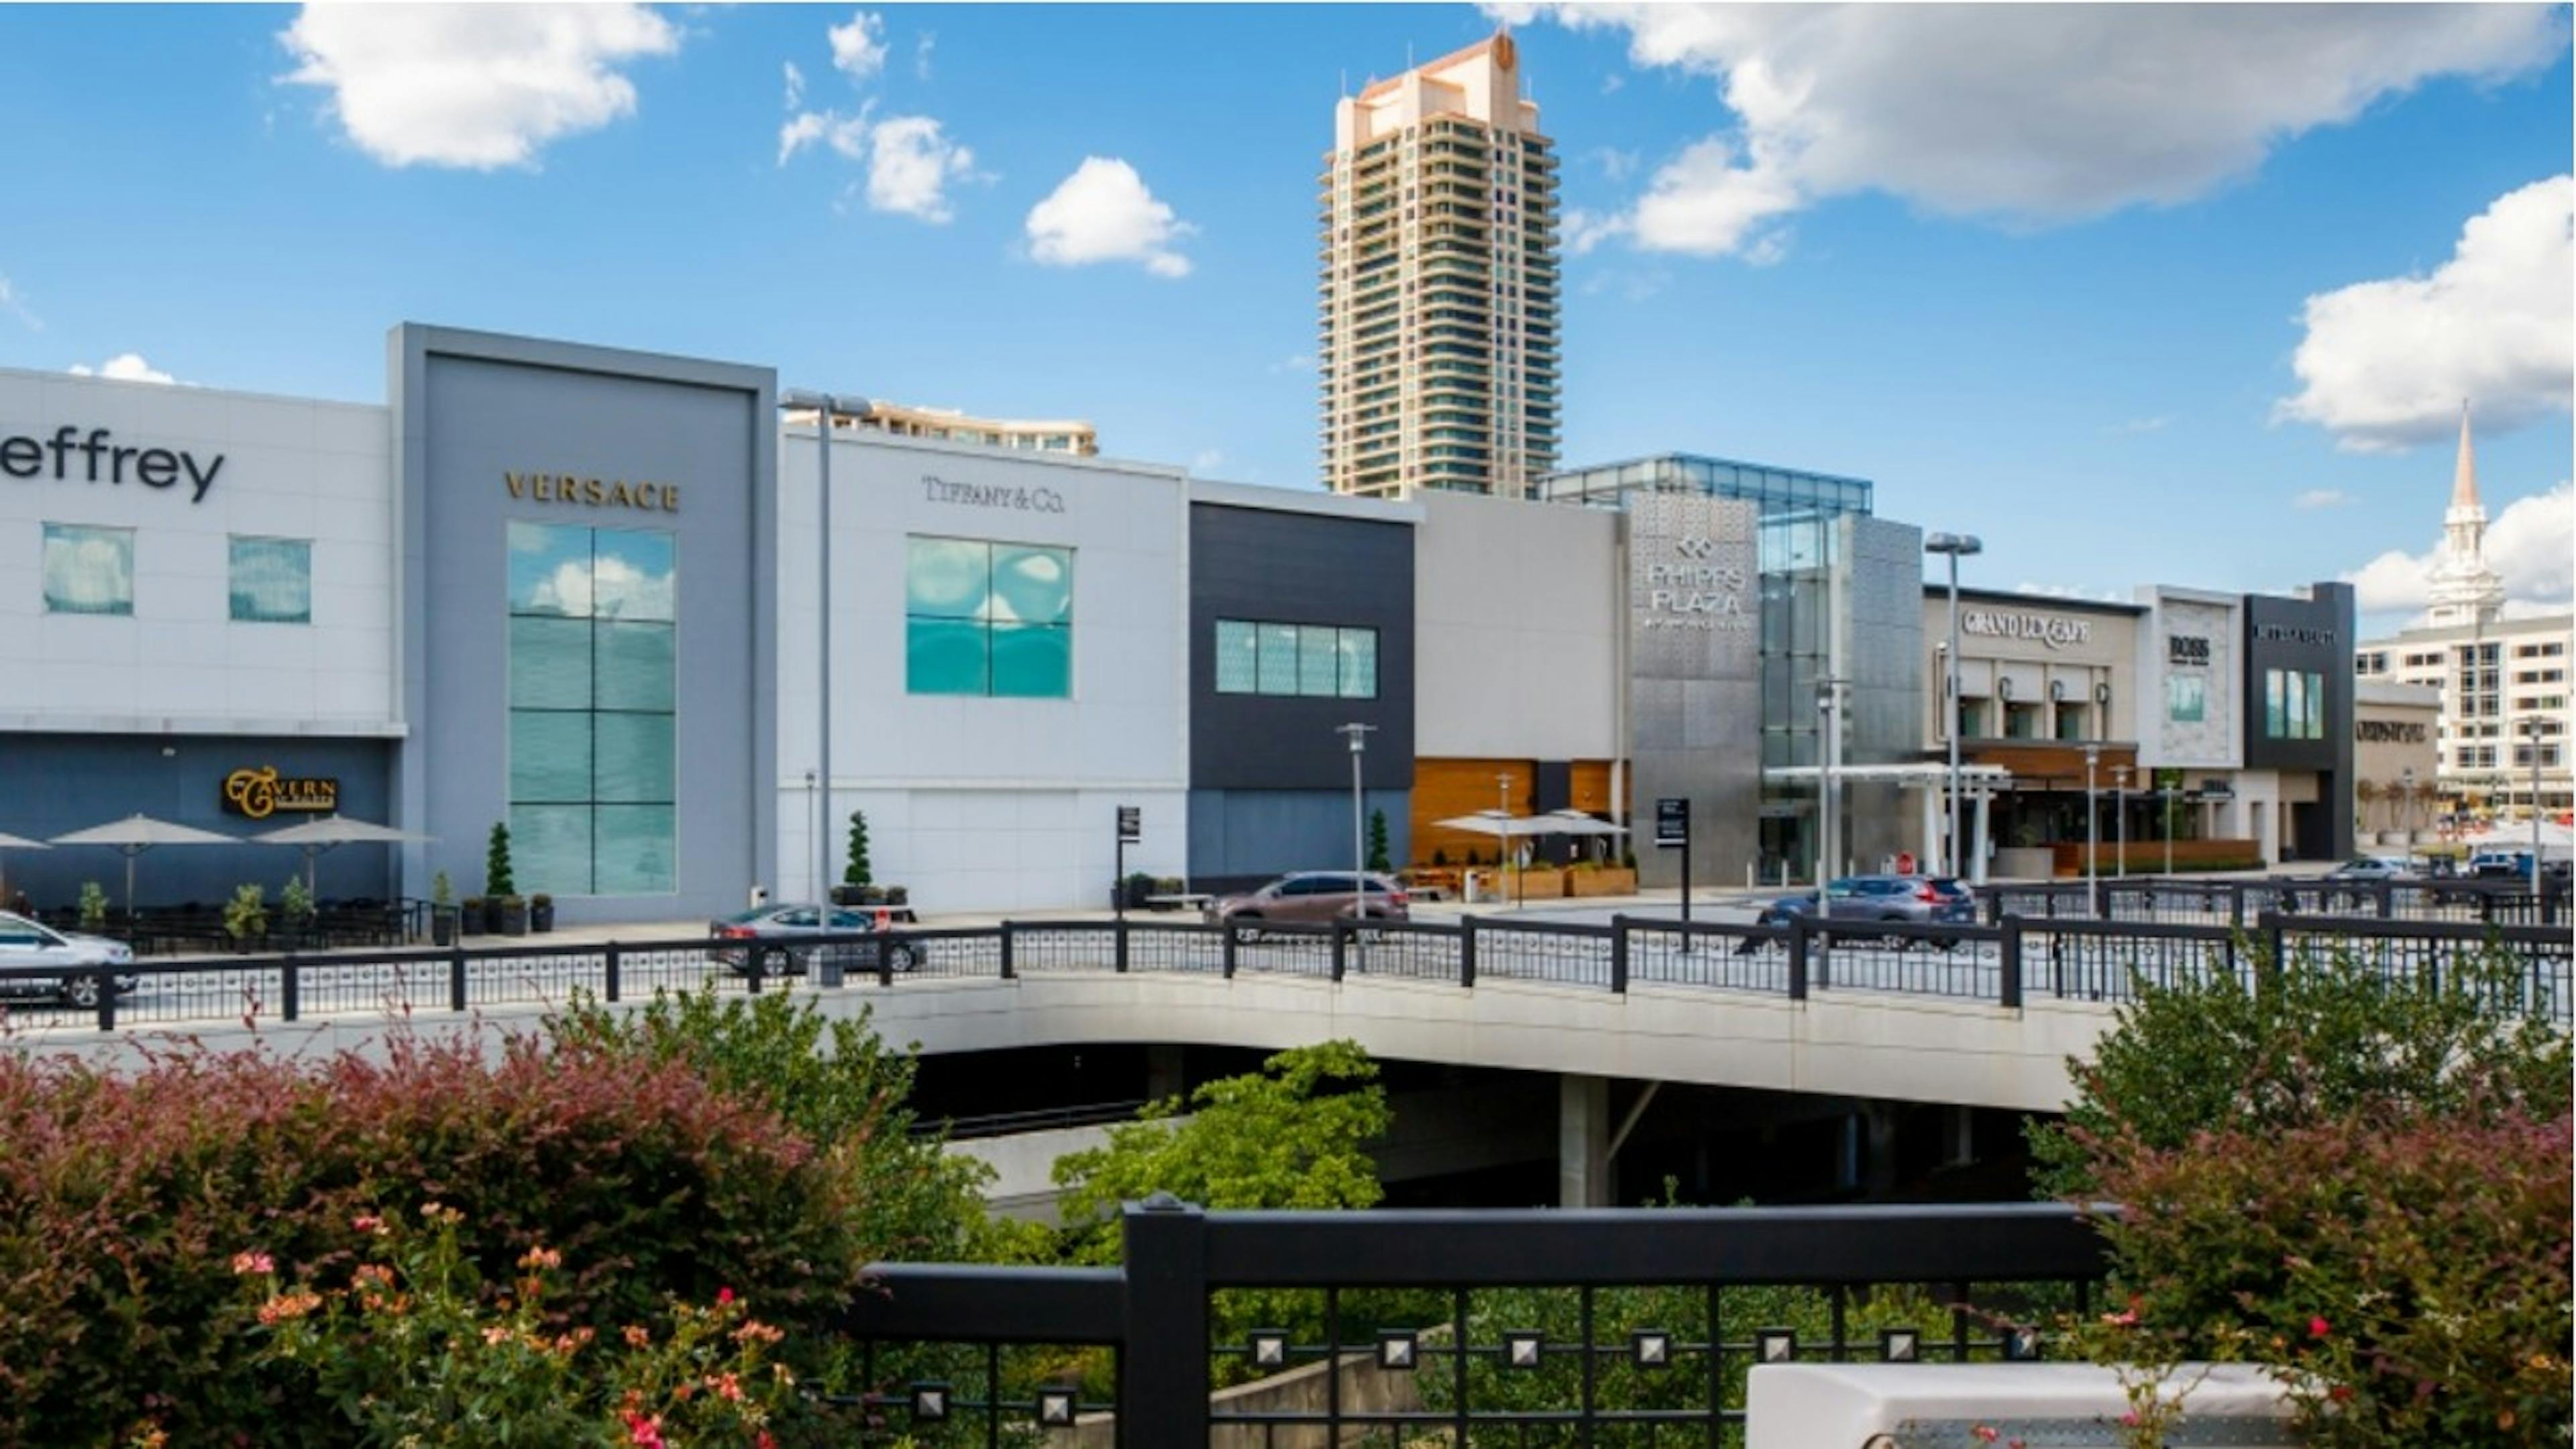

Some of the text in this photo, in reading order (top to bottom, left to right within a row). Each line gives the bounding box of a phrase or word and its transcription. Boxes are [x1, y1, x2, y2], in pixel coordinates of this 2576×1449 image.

[506, 472, 679, 512] VERSACE
[1648, 564, 1746, 592] PHIPPS
[1652, 590, 1739, 614] PLAZA
[1962, 610, 2019, 635] GRAND
